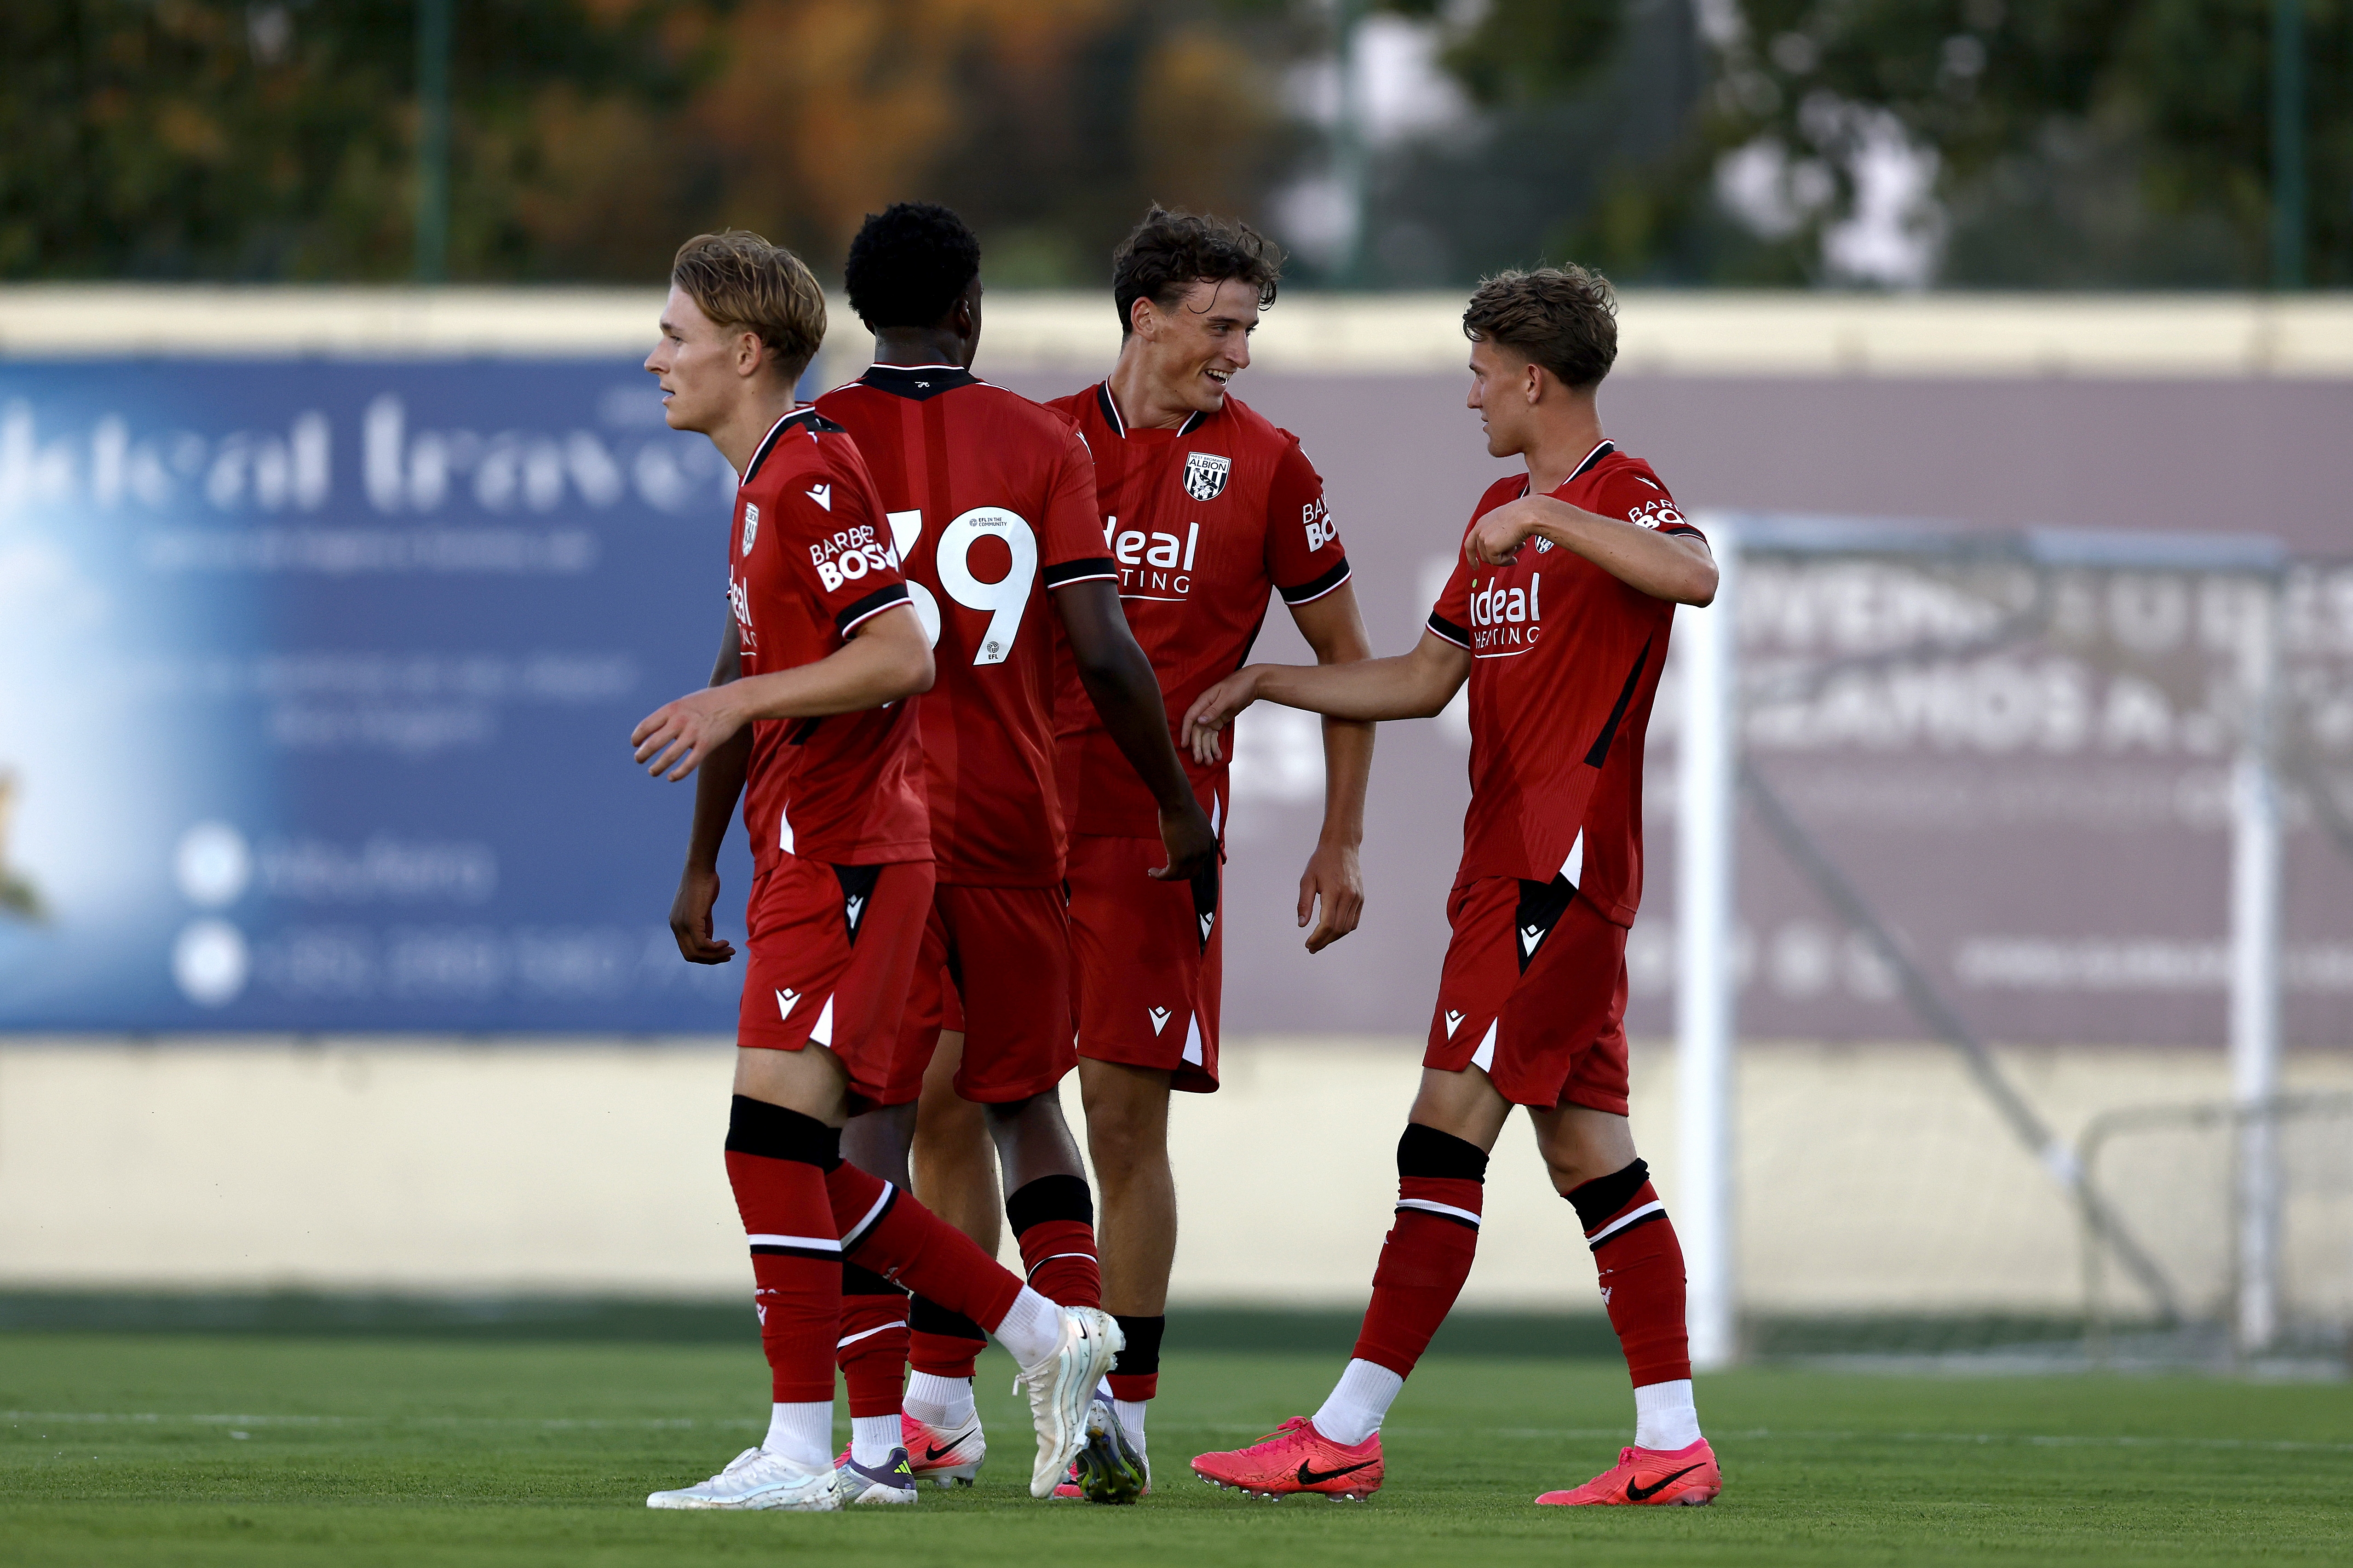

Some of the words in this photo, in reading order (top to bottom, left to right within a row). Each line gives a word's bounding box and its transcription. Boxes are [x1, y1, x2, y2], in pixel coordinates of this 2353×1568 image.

[1189, 459, 1226, 471] ALBION
[1303, 490, 1329, 524] BA
[1628, 499, 1683, 523] BAR
[1634, 509, 1687, 529] BO
[1121, 569, 1190, 593] TING
[1470, 572, 1540, 626] ideal
